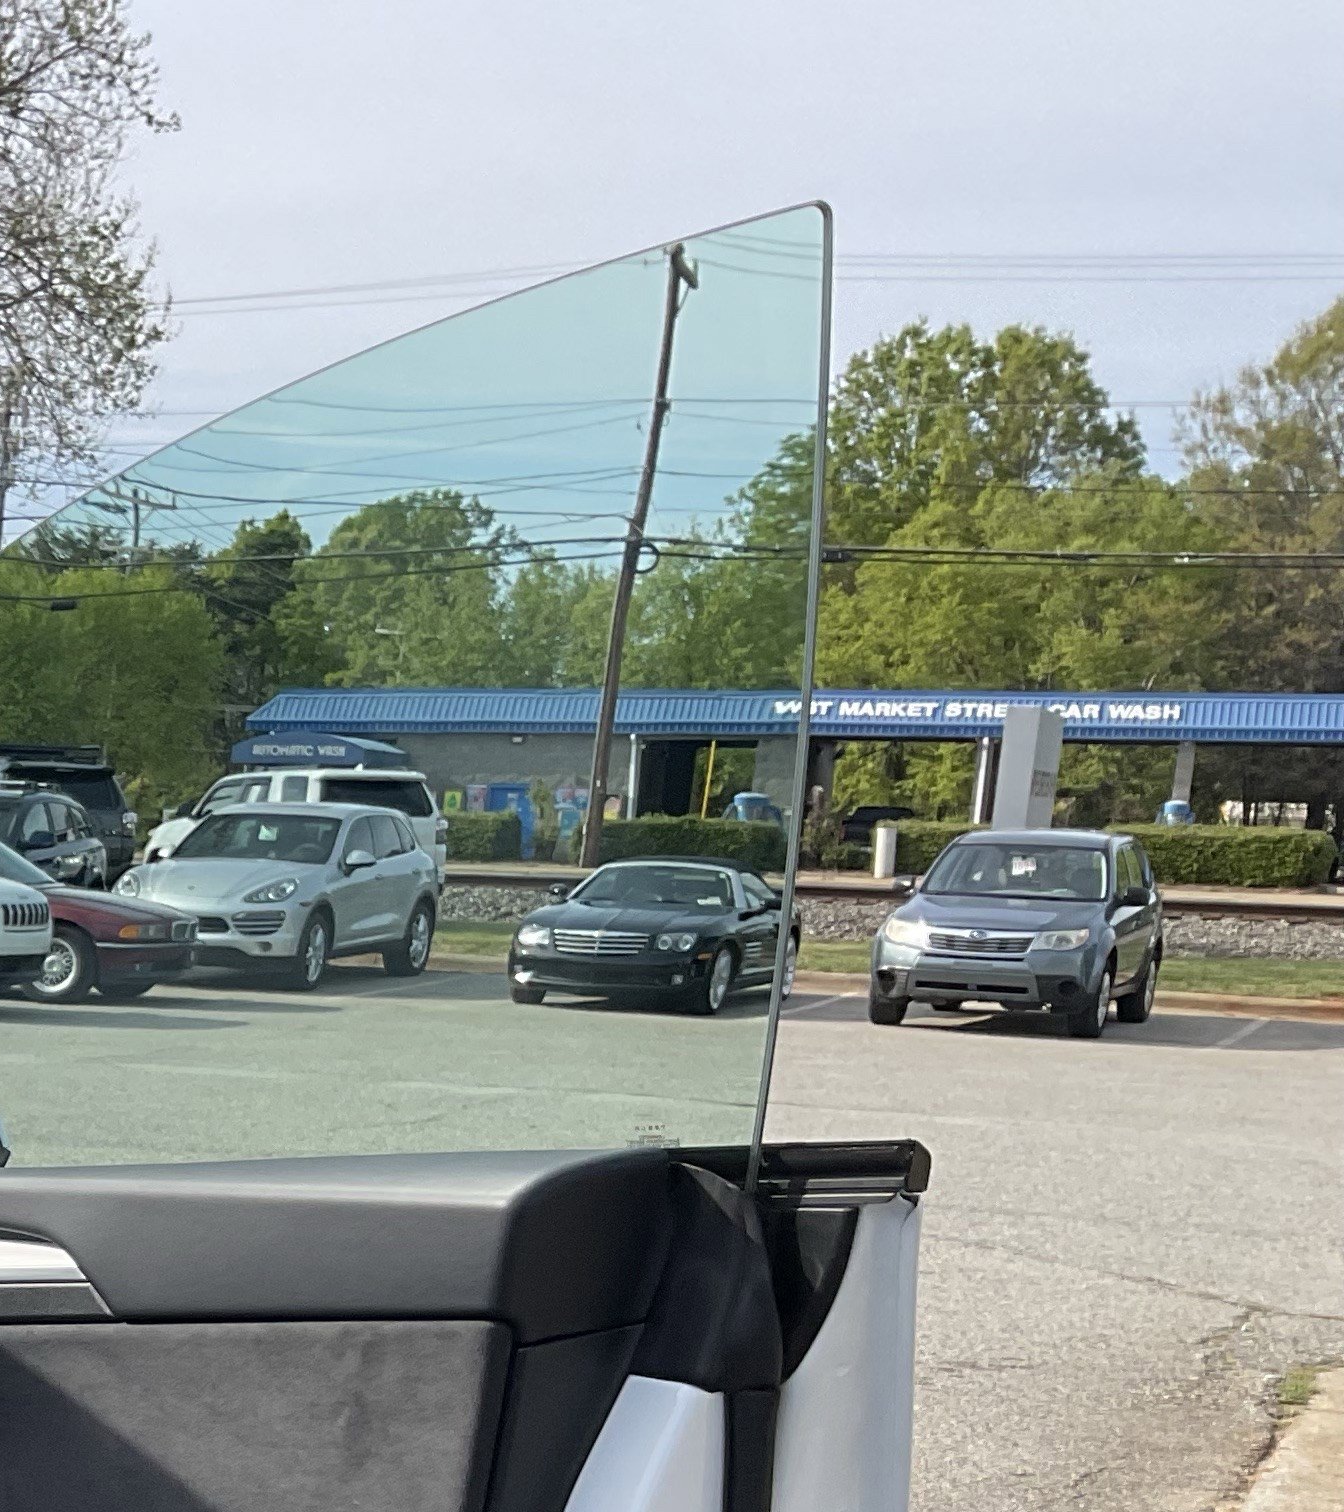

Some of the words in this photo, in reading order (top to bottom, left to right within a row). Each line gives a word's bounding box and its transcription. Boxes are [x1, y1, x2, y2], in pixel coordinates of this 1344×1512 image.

[838, 700, 940, 717] MARKET
[945, 702, 1009, 718] STRE
[1109, 704, 1181, 720] WASH
